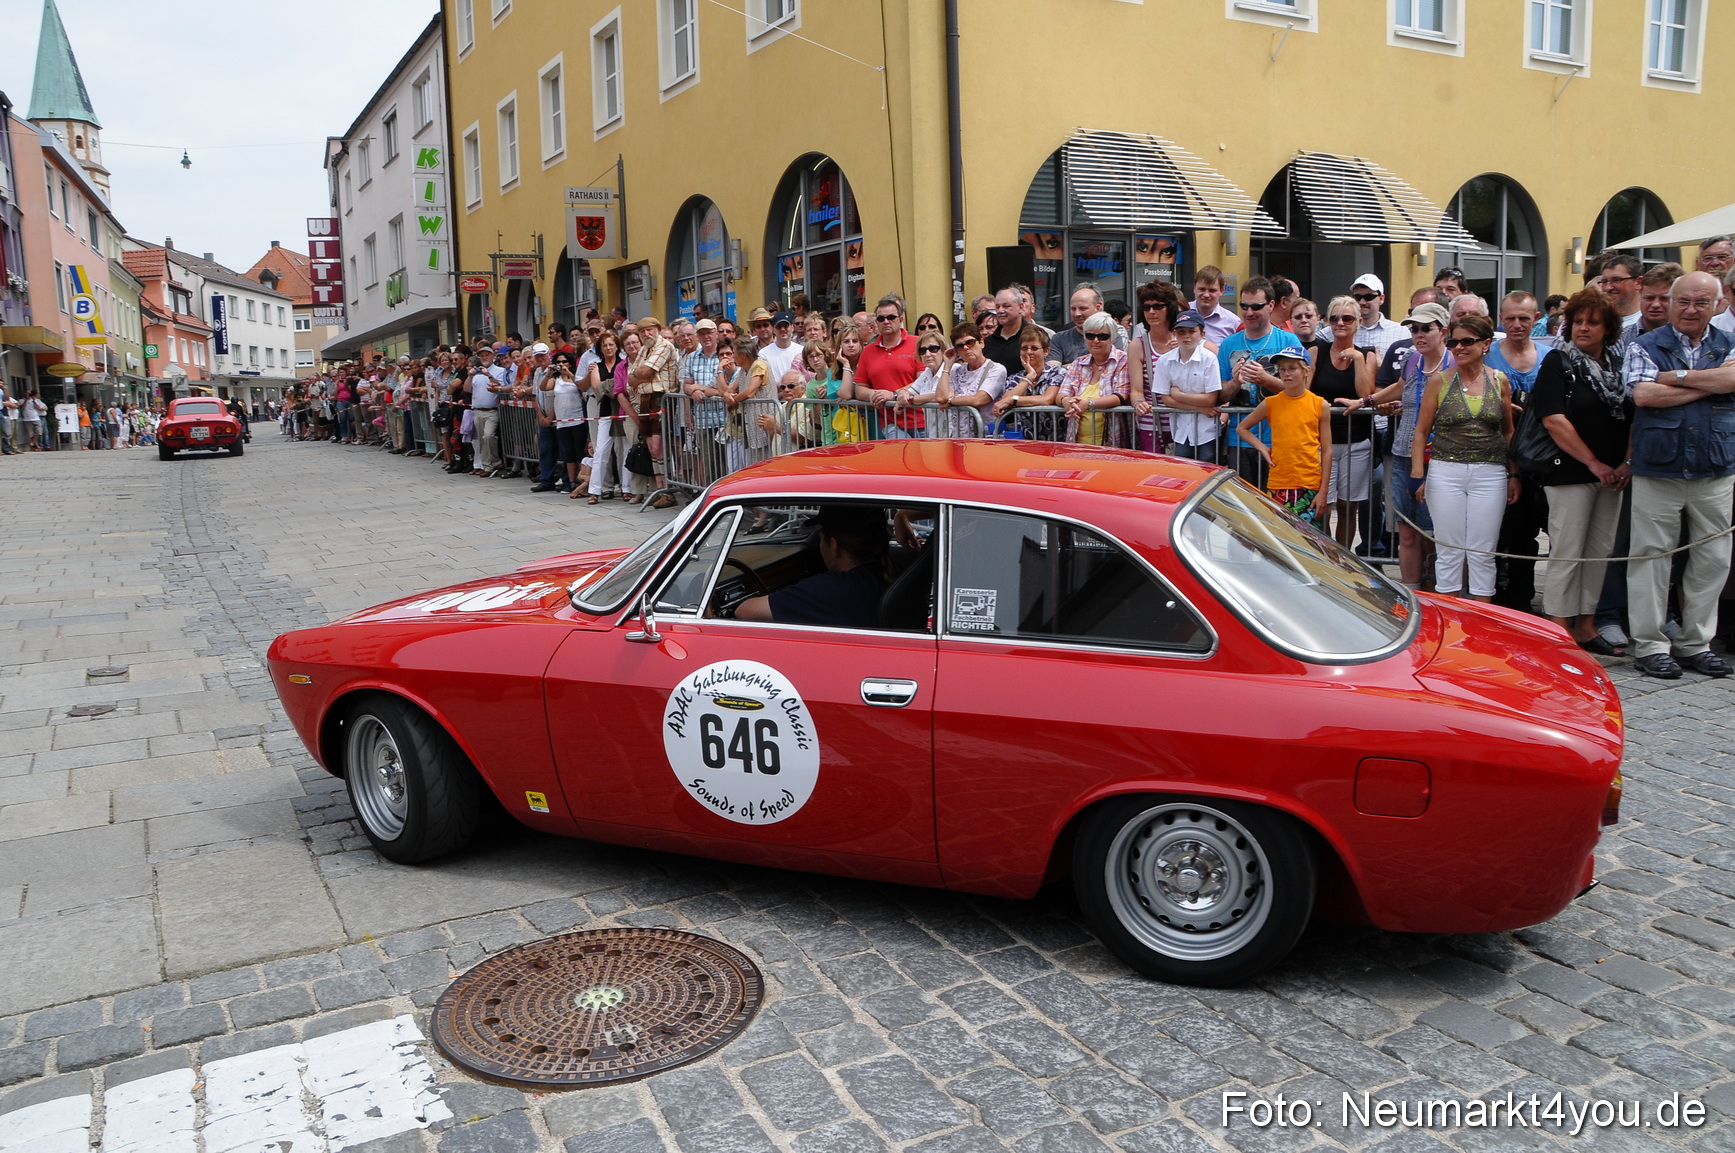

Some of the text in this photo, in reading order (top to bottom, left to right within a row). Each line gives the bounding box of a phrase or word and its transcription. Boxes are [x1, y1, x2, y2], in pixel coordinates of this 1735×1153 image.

[569, 191, 603, 200] RATHAUS
[416, 147, 444, 271] KIWI
[308, 218, 333, 302] WITT
[1077, 256, 1120, 270] hailer
[1038, 264, 1057, 273] Bilder
[1144, 268, 1172, 277] Passbilder
[76, 300, 90, 314] B
[314, 307, 344, 317] WITT
[219, 300, 227, 331] TAILOR
[951, 621, 995, 630] RICHTER
[667, 665, 813, 750] ADAC Salzburgring Classic
[699, 713, 781, 776] 646
[688, 778, 795, 821] Sounds of Speed
